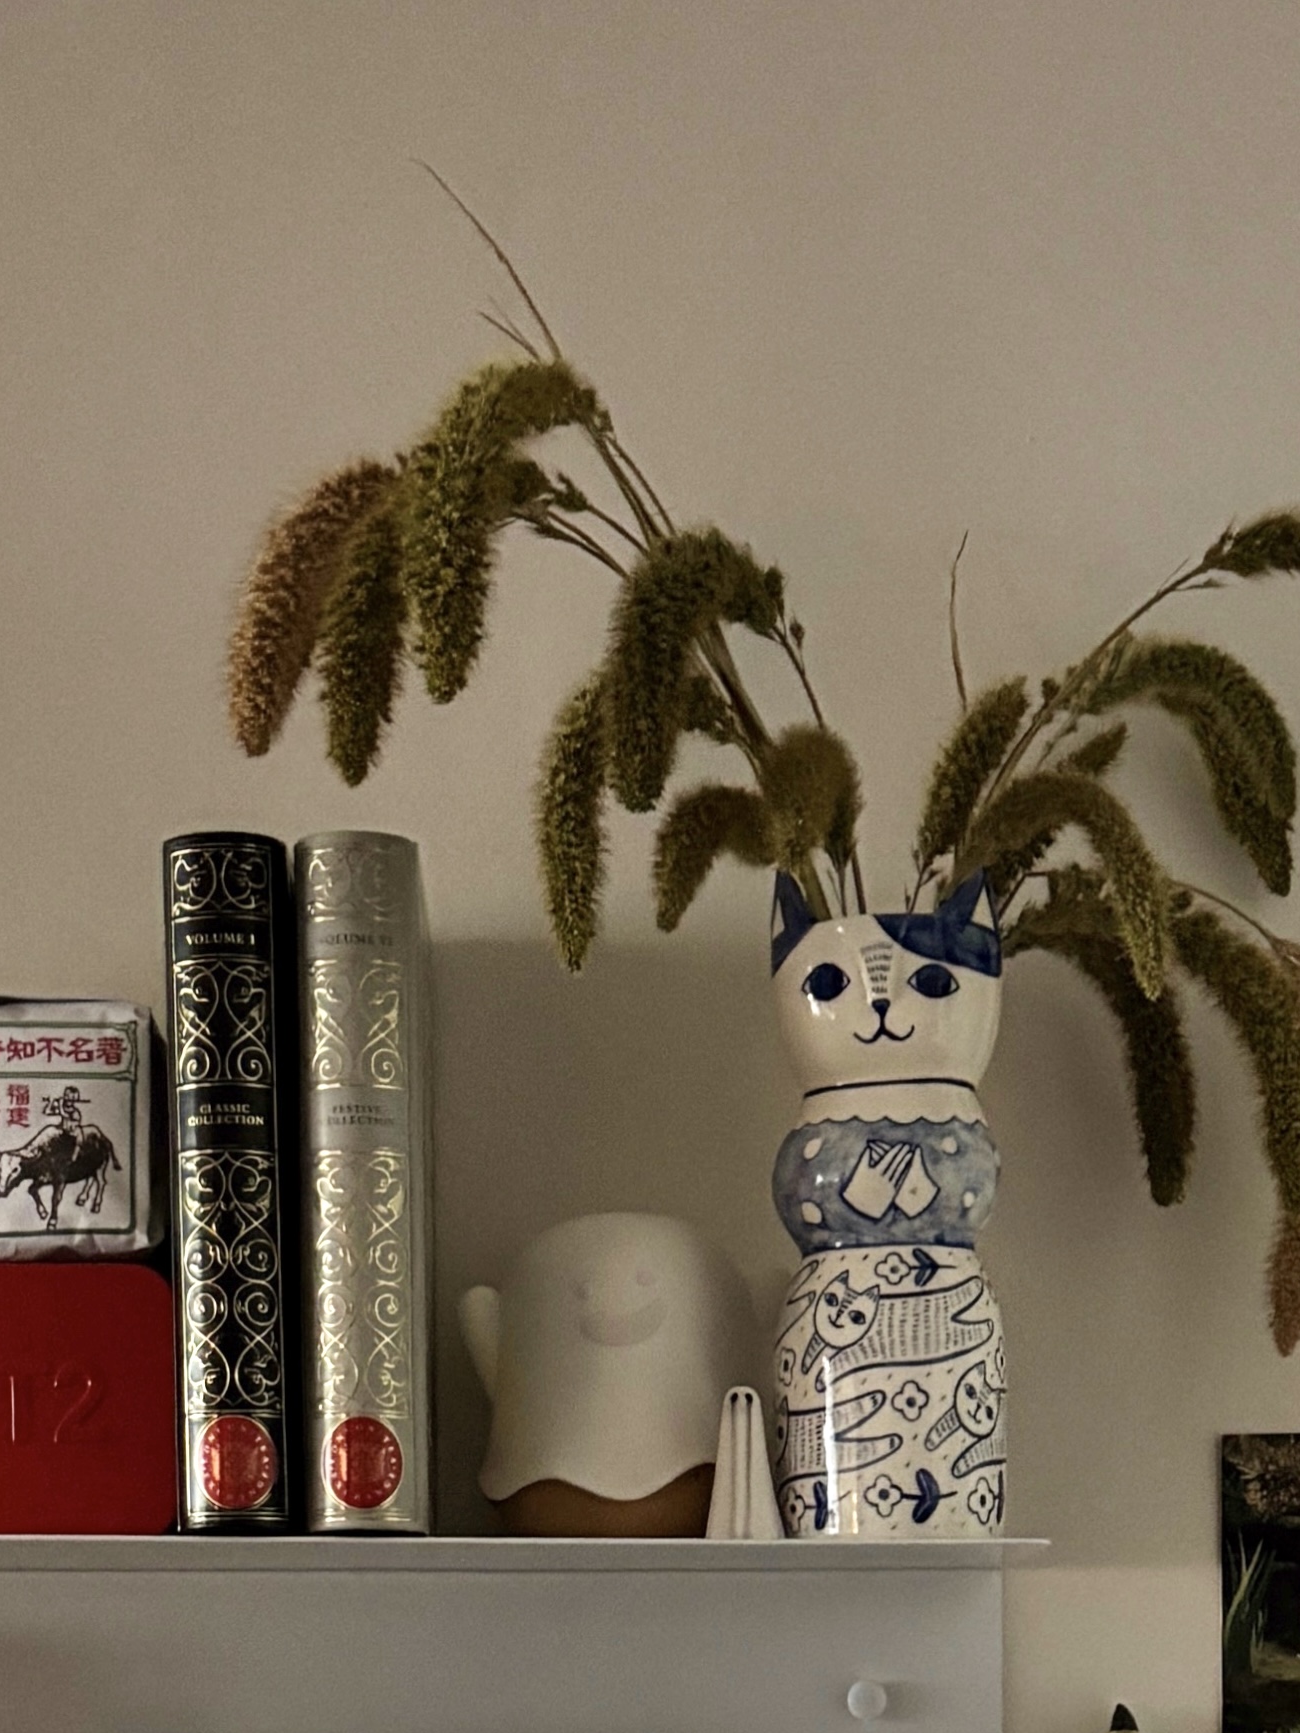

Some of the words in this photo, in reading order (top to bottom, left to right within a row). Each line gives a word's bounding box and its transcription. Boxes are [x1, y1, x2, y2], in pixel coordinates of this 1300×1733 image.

[186, 933, 245, 945] VOLUME
[319, 933, 375, 946] OLUME
[200, 1103, 250, 1114] CLASSIC
[188, 1115, 265, 1127] COLLECTION
